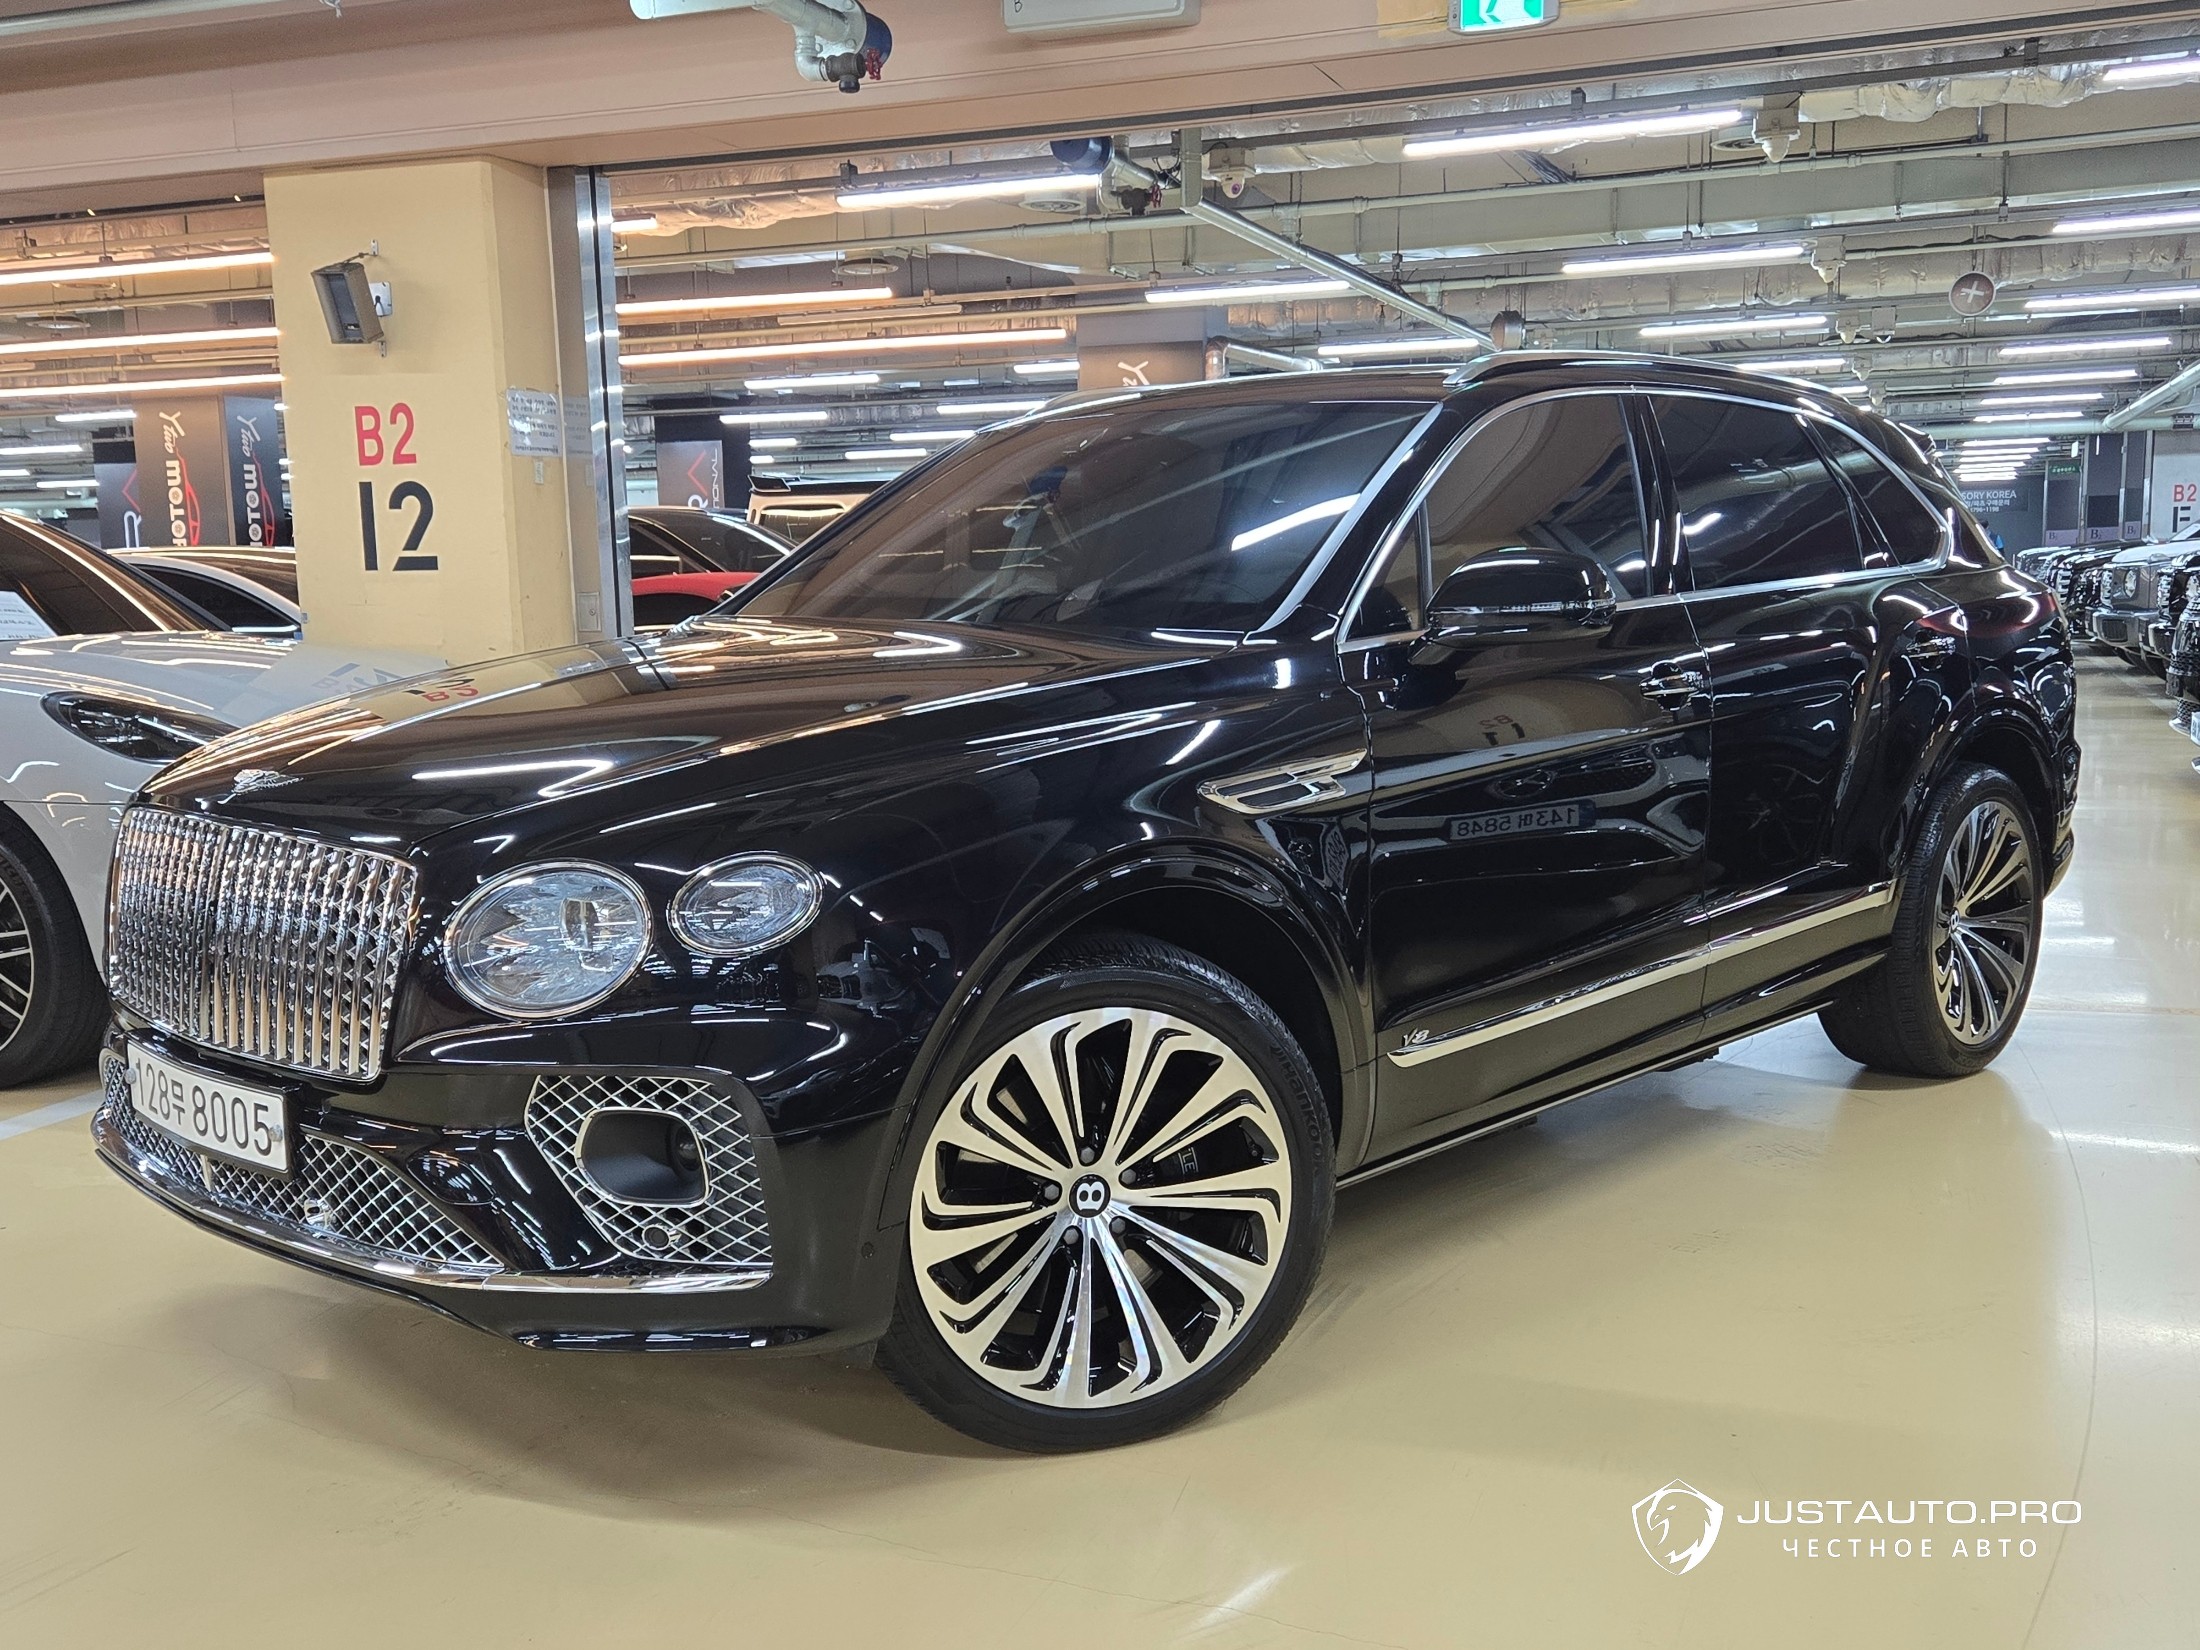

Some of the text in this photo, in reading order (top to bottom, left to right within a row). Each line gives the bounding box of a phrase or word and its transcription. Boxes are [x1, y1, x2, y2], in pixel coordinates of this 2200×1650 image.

[354, 402, 417, 466] B2
[1986, 489, 2017, 499] KOREA
[2173, 484, 2197, 502] B2
[359, 481, 438, 571] 12
[1402, 1028, 1430, 1046] V8
[136, 1058, 272, 1157] 128무 8005
